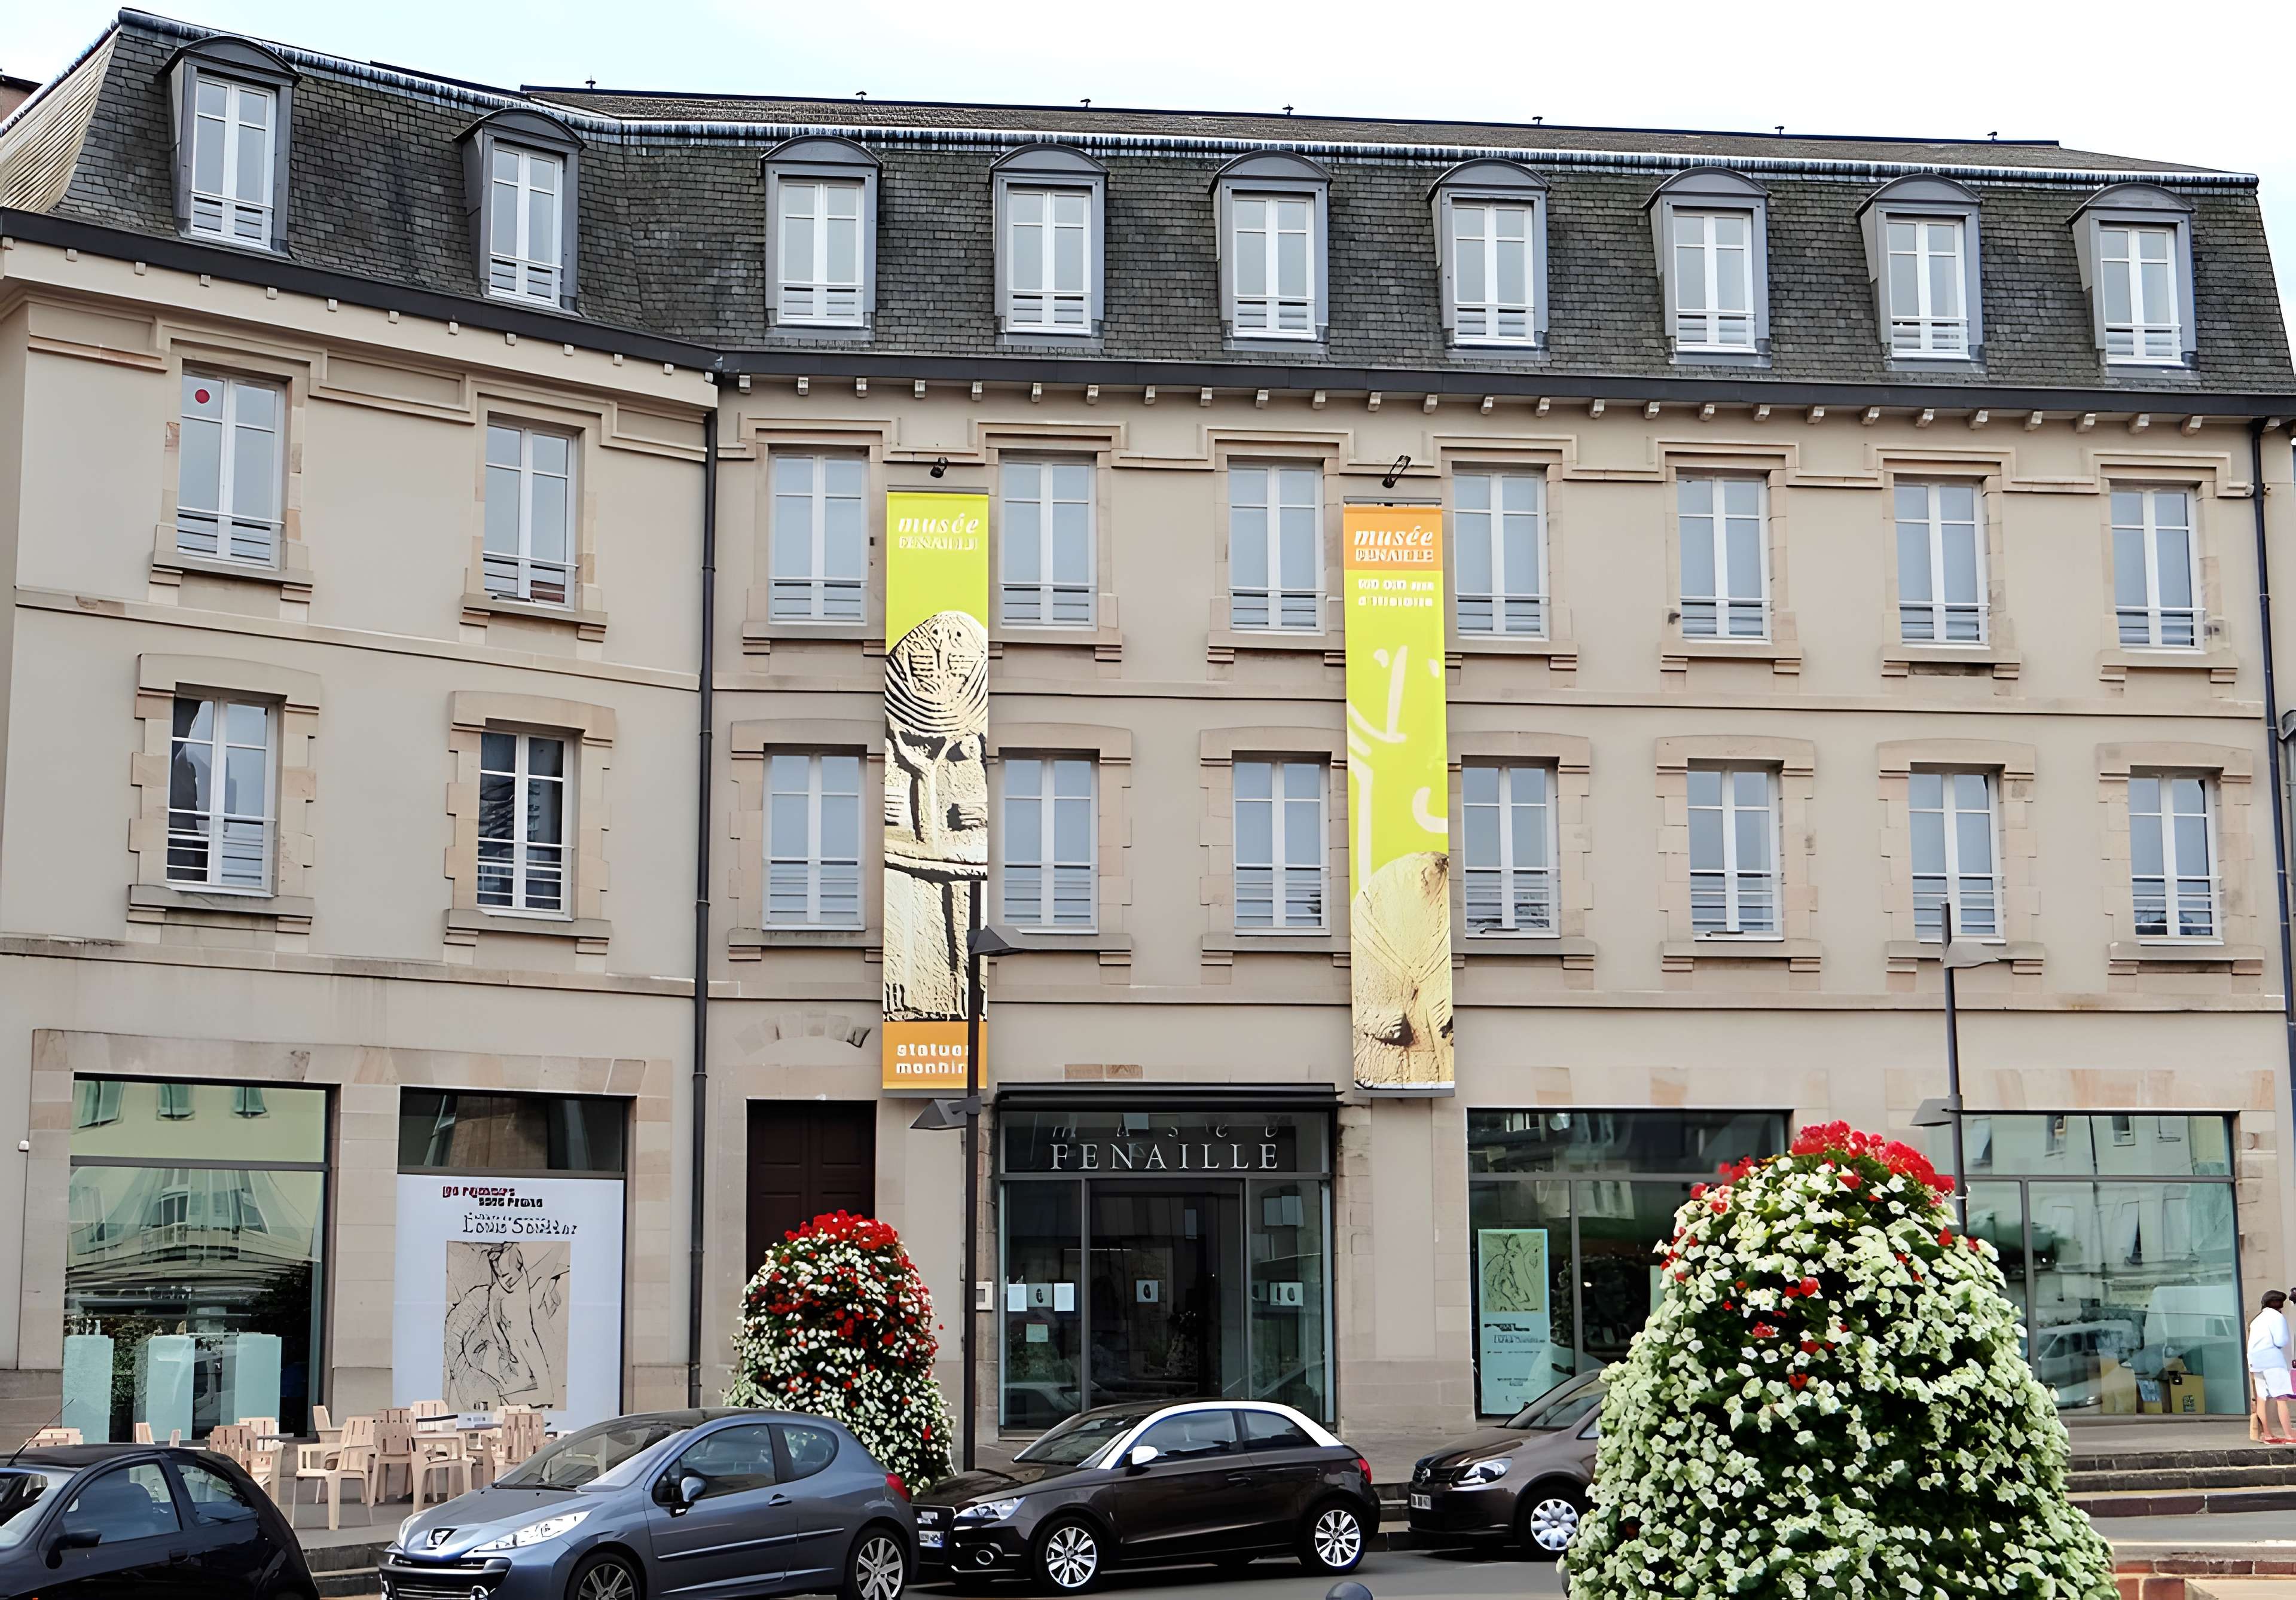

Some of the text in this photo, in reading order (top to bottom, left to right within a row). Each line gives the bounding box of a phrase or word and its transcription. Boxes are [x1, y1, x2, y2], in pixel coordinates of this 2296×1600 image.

[899, 512, 979, 533] musée
[1354, 526, 1433, 545] musée
[897, 1043, 968, 1057] statue
[1050, 1143, 1278, 1170] FENAILLE
